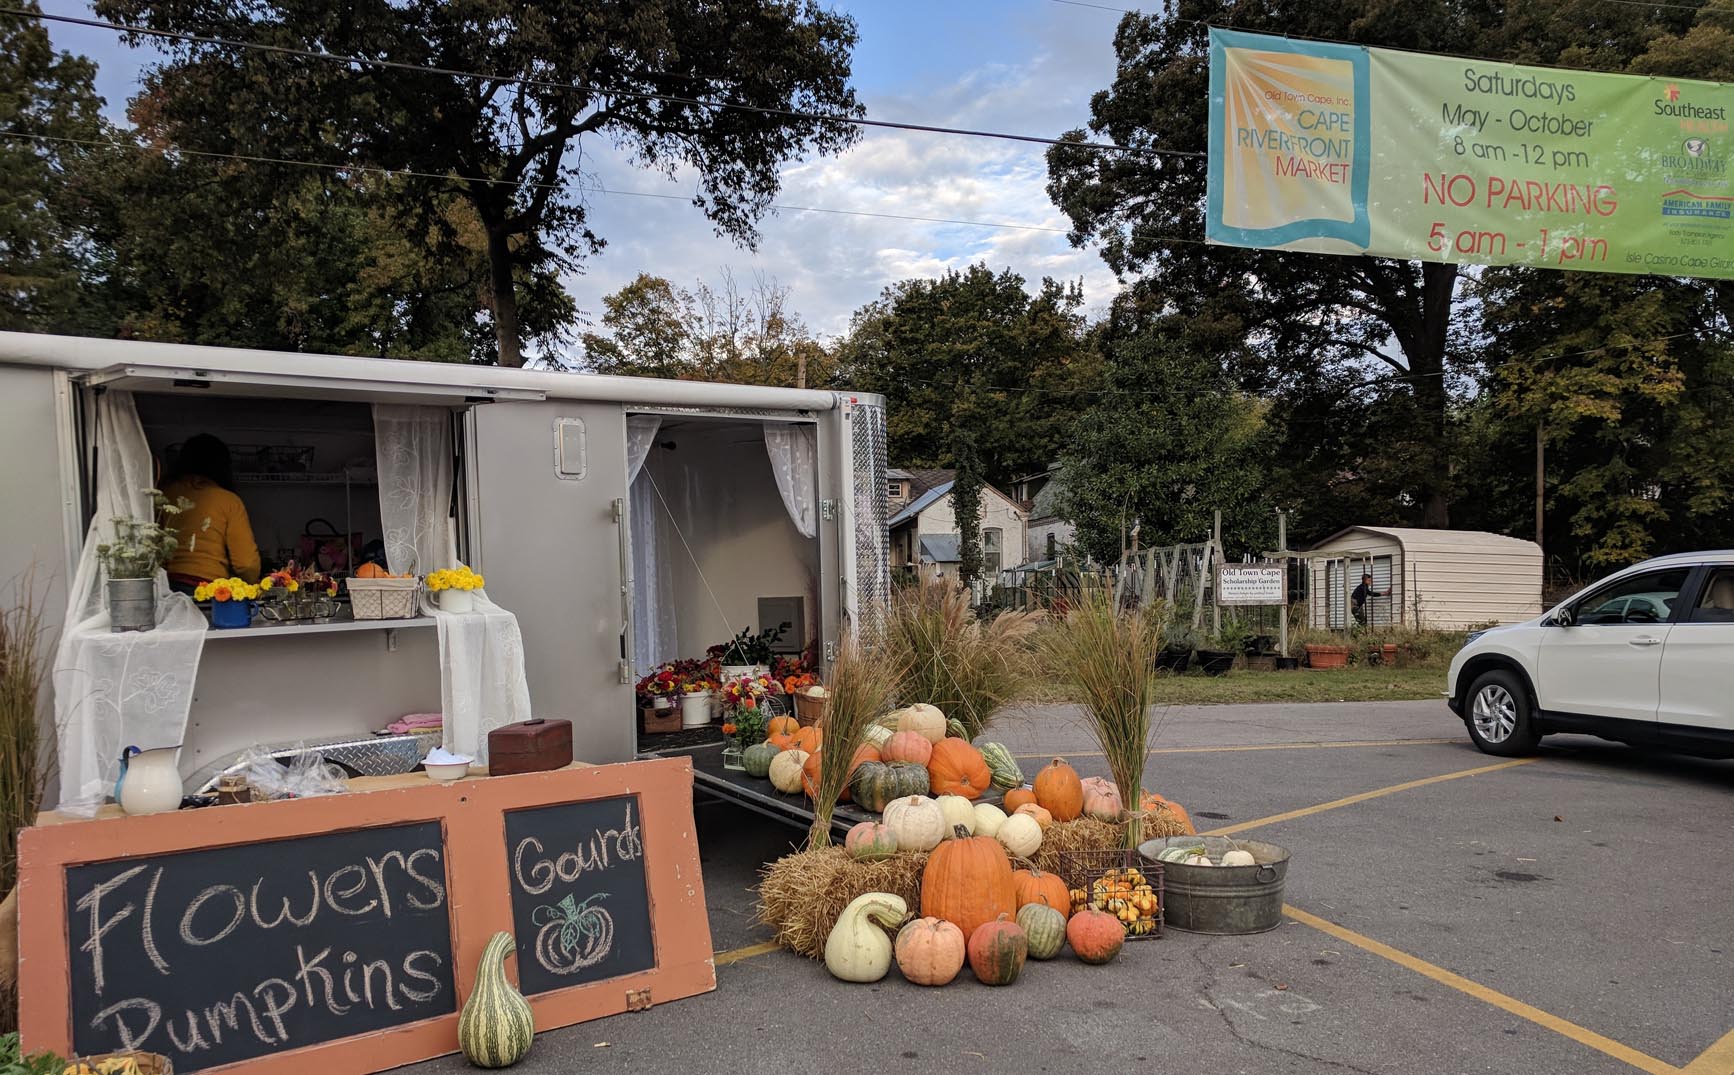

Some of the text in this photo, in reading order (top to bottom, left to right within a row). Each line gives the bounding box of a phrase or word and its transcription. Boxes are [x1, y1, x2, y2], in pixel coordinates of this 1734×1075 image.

[1264, 90, 1281, 100] Old
[1284, 91, 1306, 103] Town
[1464, 68, 1576, 105] Saturdays
[1298, 110, 1350, 132] CAPE
[1442, 103, 1489, 132] May
[1509, 109, 1593, 137] October
[1654, 99, 1726, 120] Southeast
[1237, 127, 1351, 159] RIVERFRONT
[1454, 135, 1466, 155] 8
[1472, 142, 1506, 161] am
[1552, 150, 1589, 170] pm
[1275, 155, 1350, 184] MARKET
[1662, 155, 1726, 173] BROADWAY
[1424, 173, 1617, 217] NO PARKING
[1428, 223, 1446, 252] 5
[1456, 230, 1506, 255] am
[1540, 229, 1549, 256] 1
[1559, 236, 1608, 264] pm
[1222, 568, 1280, 577] Old Town Cape
[514, 793, 643, 894] Gourds
[76, 848, 445, 994] Flowers
[90, 944, 442, 1051] Pumpkins
